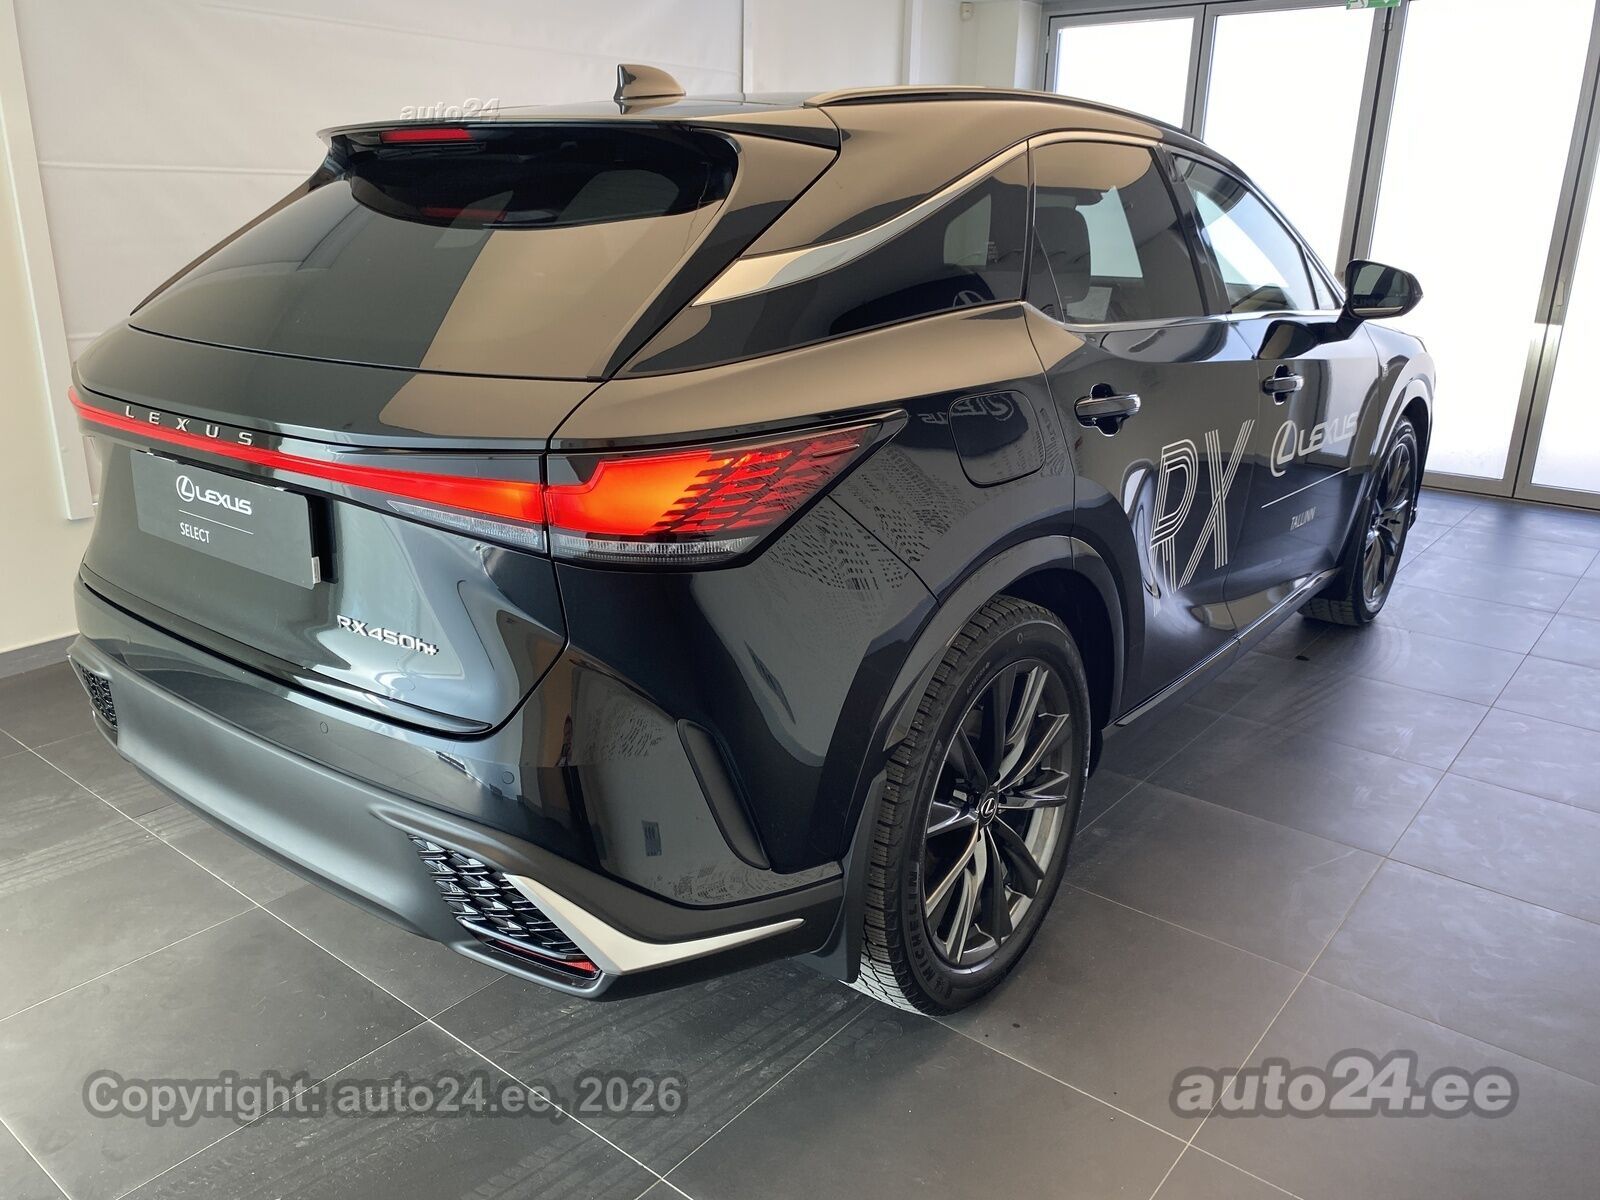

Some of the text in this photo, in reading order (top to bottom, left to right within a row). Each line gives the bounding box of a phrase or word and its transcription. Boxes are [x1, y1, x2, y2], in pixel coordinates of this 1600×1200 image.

[125, 405, 253, 446] LEXUS
[1297, 411, 1358, 457] LEXUS
[195, 485, 252, 515] LEXUS
[1149, 418, 1256, 617] RX
[180, 522, 210, 544] SELECT
[336, 614, 440, 656] RX450h+
